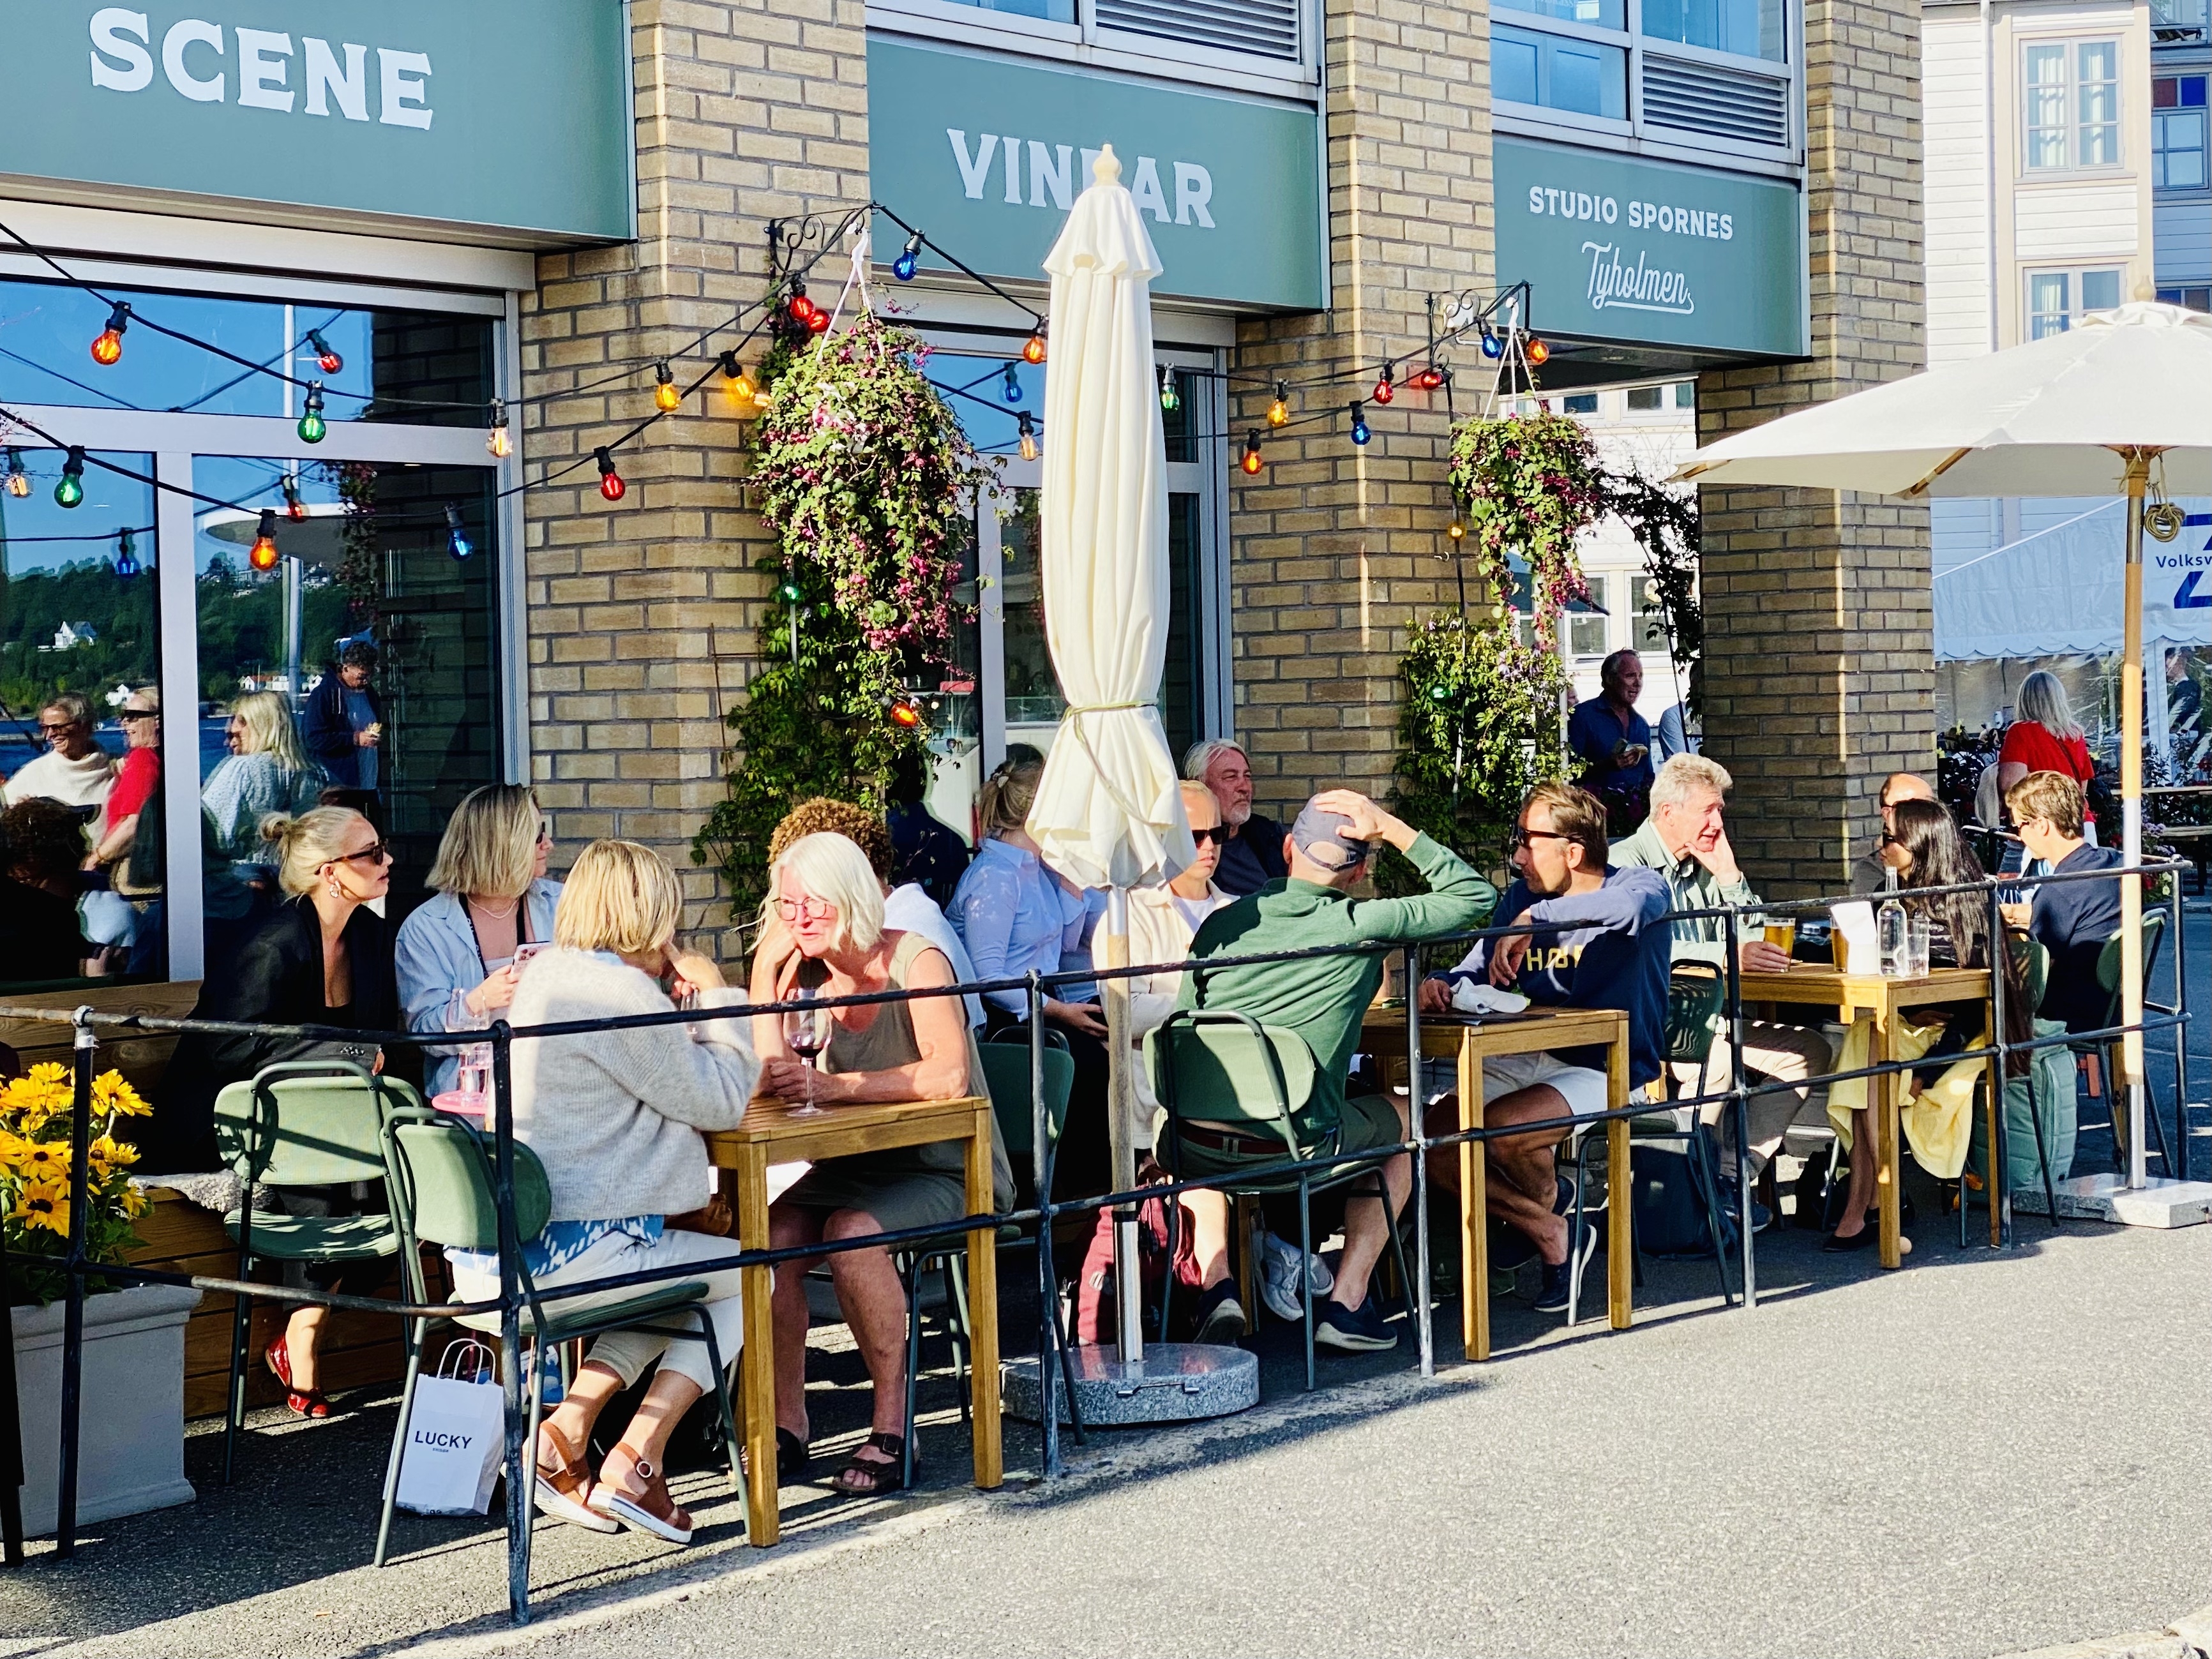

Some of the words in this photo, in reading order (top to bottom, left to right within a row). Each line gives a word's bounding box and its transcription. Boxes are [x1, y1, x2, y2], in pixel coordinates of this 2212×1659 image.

[88, 6, 433, 131] SCENE
[1529, 186, 1618, 225] STUDIO
[1628, 200, 1734, 241] SPORNES
[1581, 241, 1693, 312] Tyholmen
[414, 1430, 473, 1449] LUCKY
